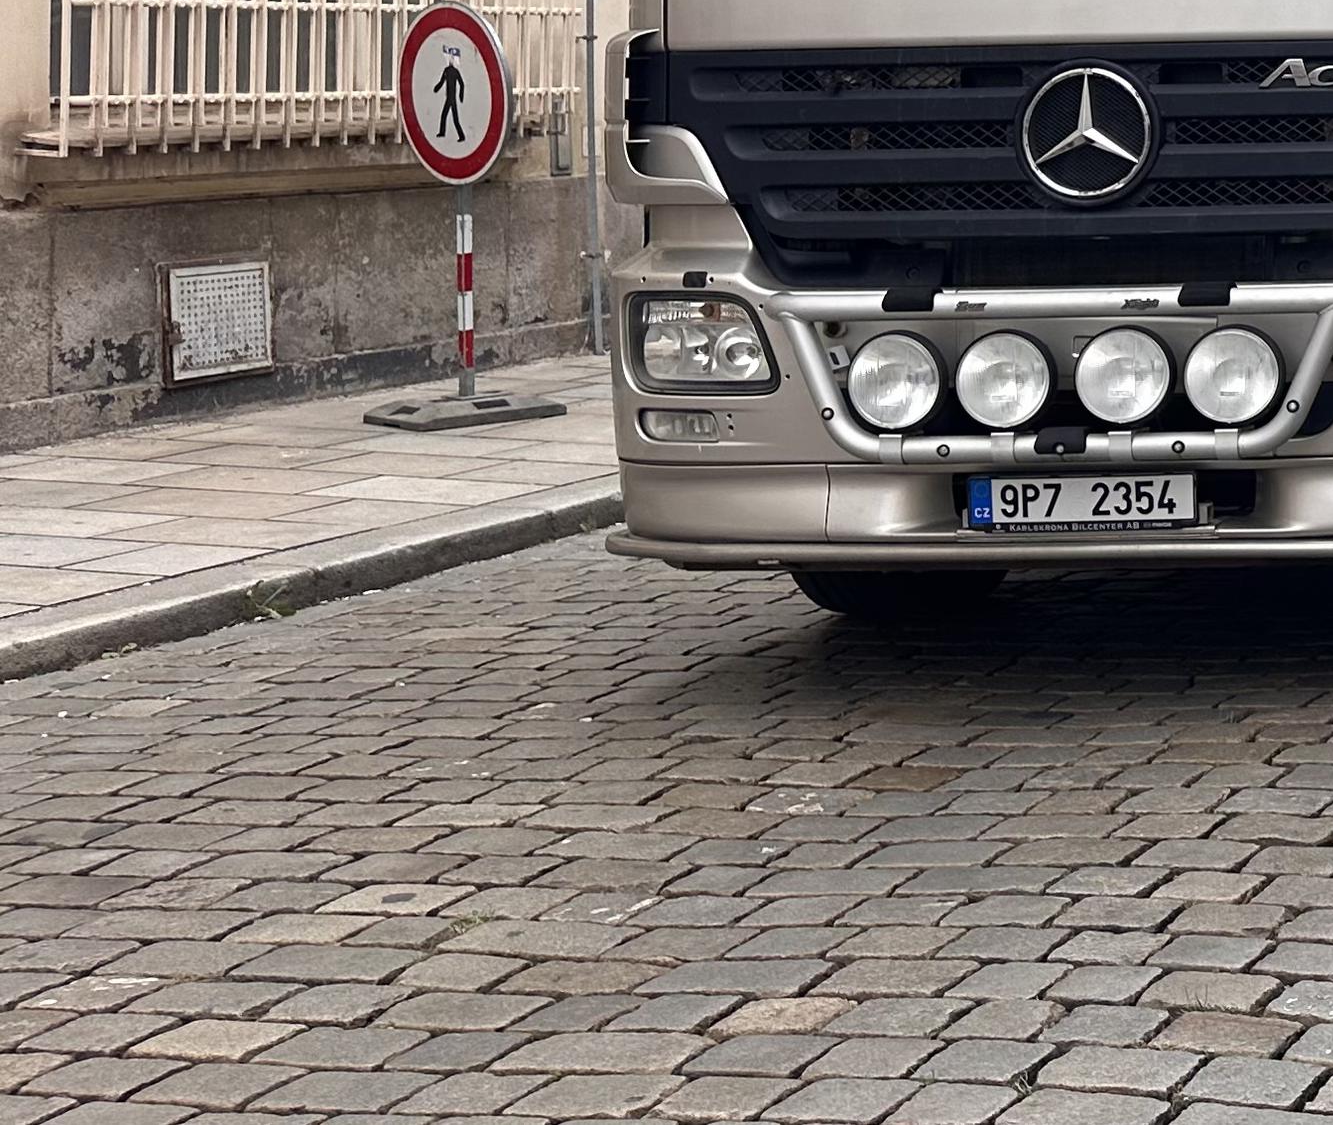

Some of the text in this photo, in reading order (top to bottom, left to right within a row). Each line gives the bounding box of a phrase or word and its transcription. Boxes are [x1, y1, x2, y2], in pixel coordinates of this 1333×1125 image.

[974, 480, 1177, 518] CZ 9P7 2354
